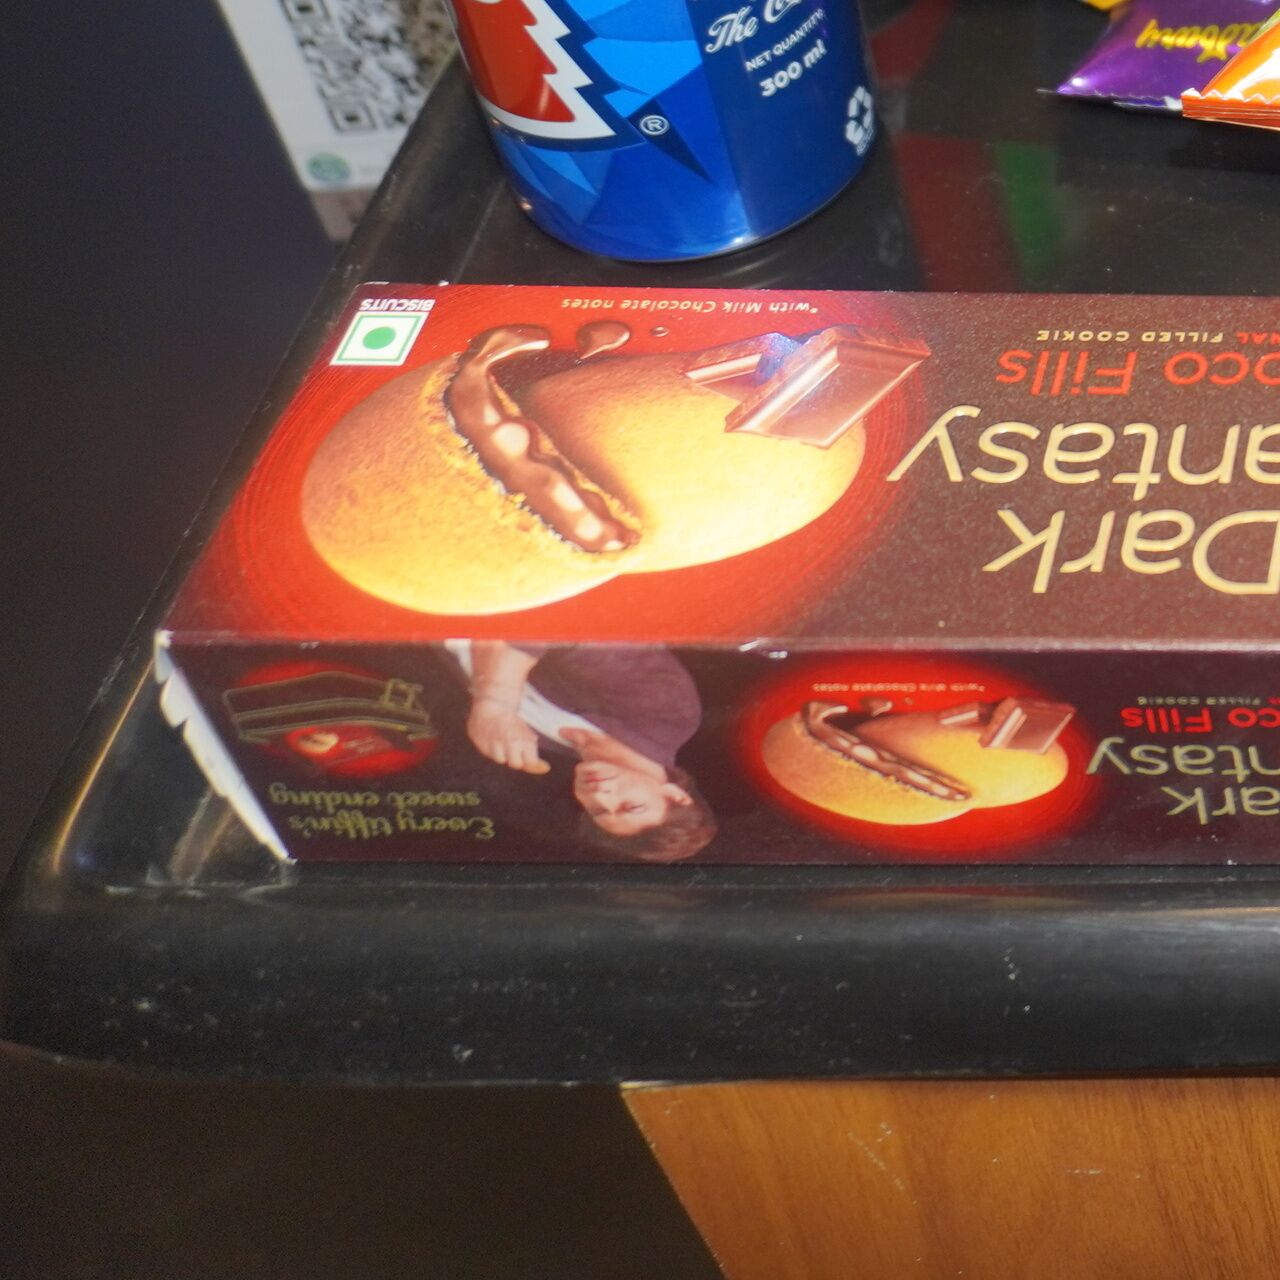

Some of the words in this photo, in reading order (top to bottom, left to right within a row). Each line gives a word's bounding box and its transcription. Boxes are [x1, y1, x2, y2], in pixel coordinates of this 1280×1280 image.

[705, 5, 759, 54] The
[1135, 19, 1266, 63] adbury
[745, 51, 772, 73] NET
[759, 60, 804, 97] 300
[360, 299, 436, 312] BISCUITS
[561, 298, 616, 310] notes
[621, 298, 717, 313] Chocolate
[723, 300, 763, 313] Milk
[1036, 329, 1131, 343] COOKIE
[1141, 330, 1224, 344] FILLED
[996, 349, 1139, 396] Fills
[1119, 707, 1215, 734] Fills
